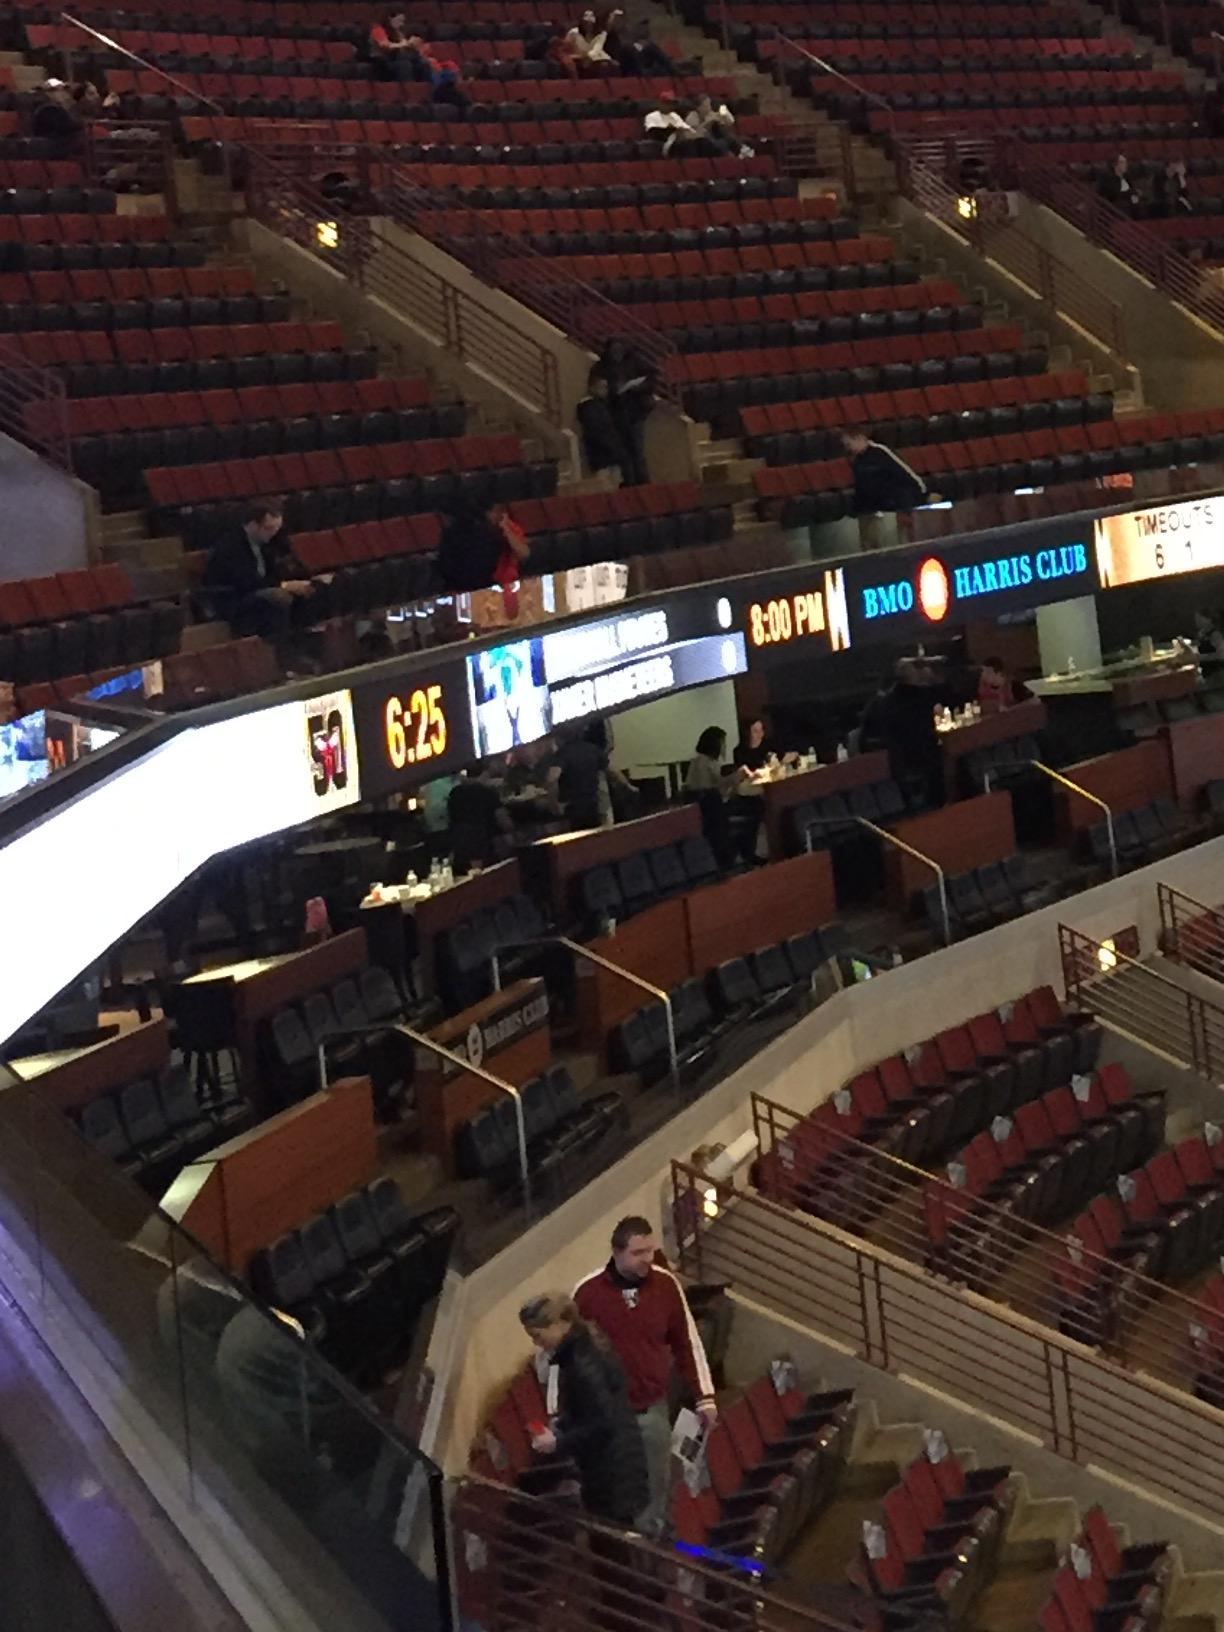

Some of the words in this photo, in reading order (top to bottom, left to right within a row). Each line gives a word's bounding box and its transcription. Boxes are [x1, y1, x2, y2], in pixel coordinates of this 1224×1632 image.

[1135, 505, 1214, 538] TIMEOUTS
[863, 580, 914, 620] BMO
[954, 556, 1034, 599] HARRIS
[1036, 542, 1088, 582] CLUB
[1155, 543, 1165, 569] 6
[749, 597, 793, 648] 8:00
[793, 590, 825, 637] PM
[384, 684, 448, 771] 6:25
